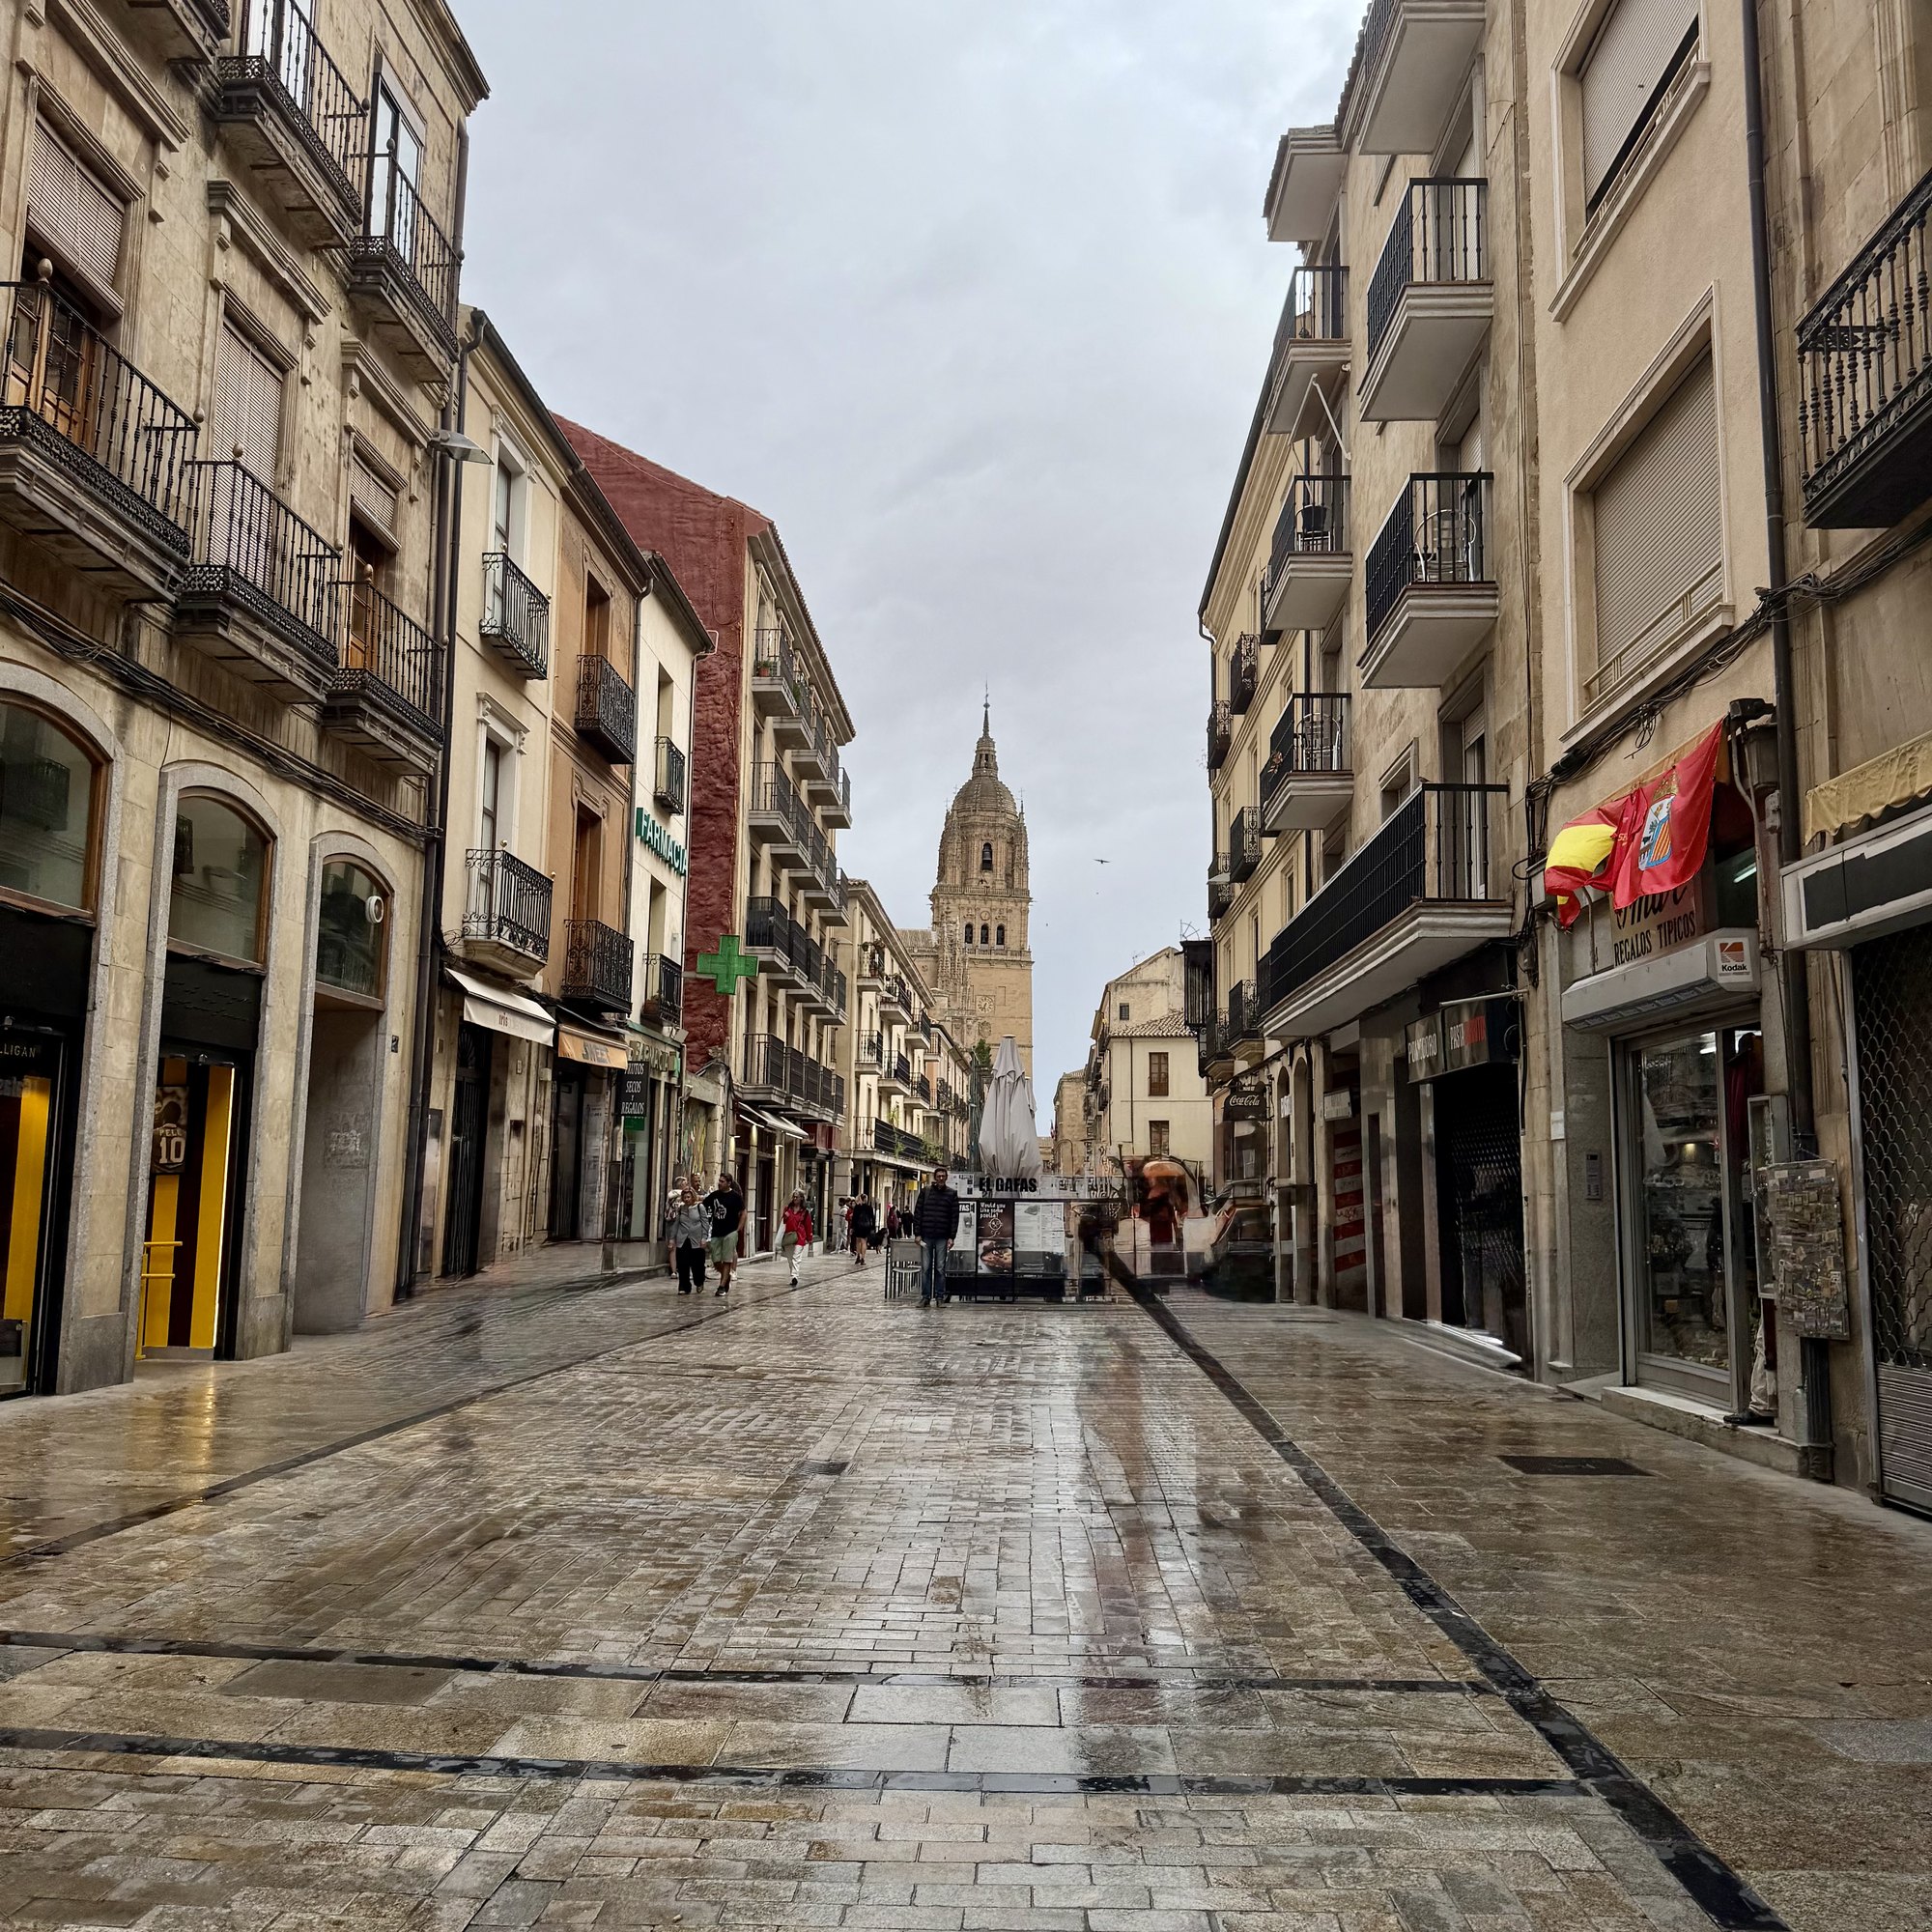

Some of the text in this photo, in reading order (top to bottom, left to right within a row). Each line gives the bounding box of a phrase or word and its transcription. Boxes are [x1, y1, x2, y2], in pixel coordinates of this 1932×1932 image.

[639, 810, 688, 874] FARMACIA
[1614, 929, 1652, 966] REGALOS
[1657, 911, 1696, 949] TIPICOS
[626, 1081, 641, 1093] SECOS
[621, 1102, 645, 1115] REGALOS
[159, 1137, 185, 1164] 10
[979, 1177, 992, 1192] EL
[995, 1177, 1037, 1193] GAFAS
